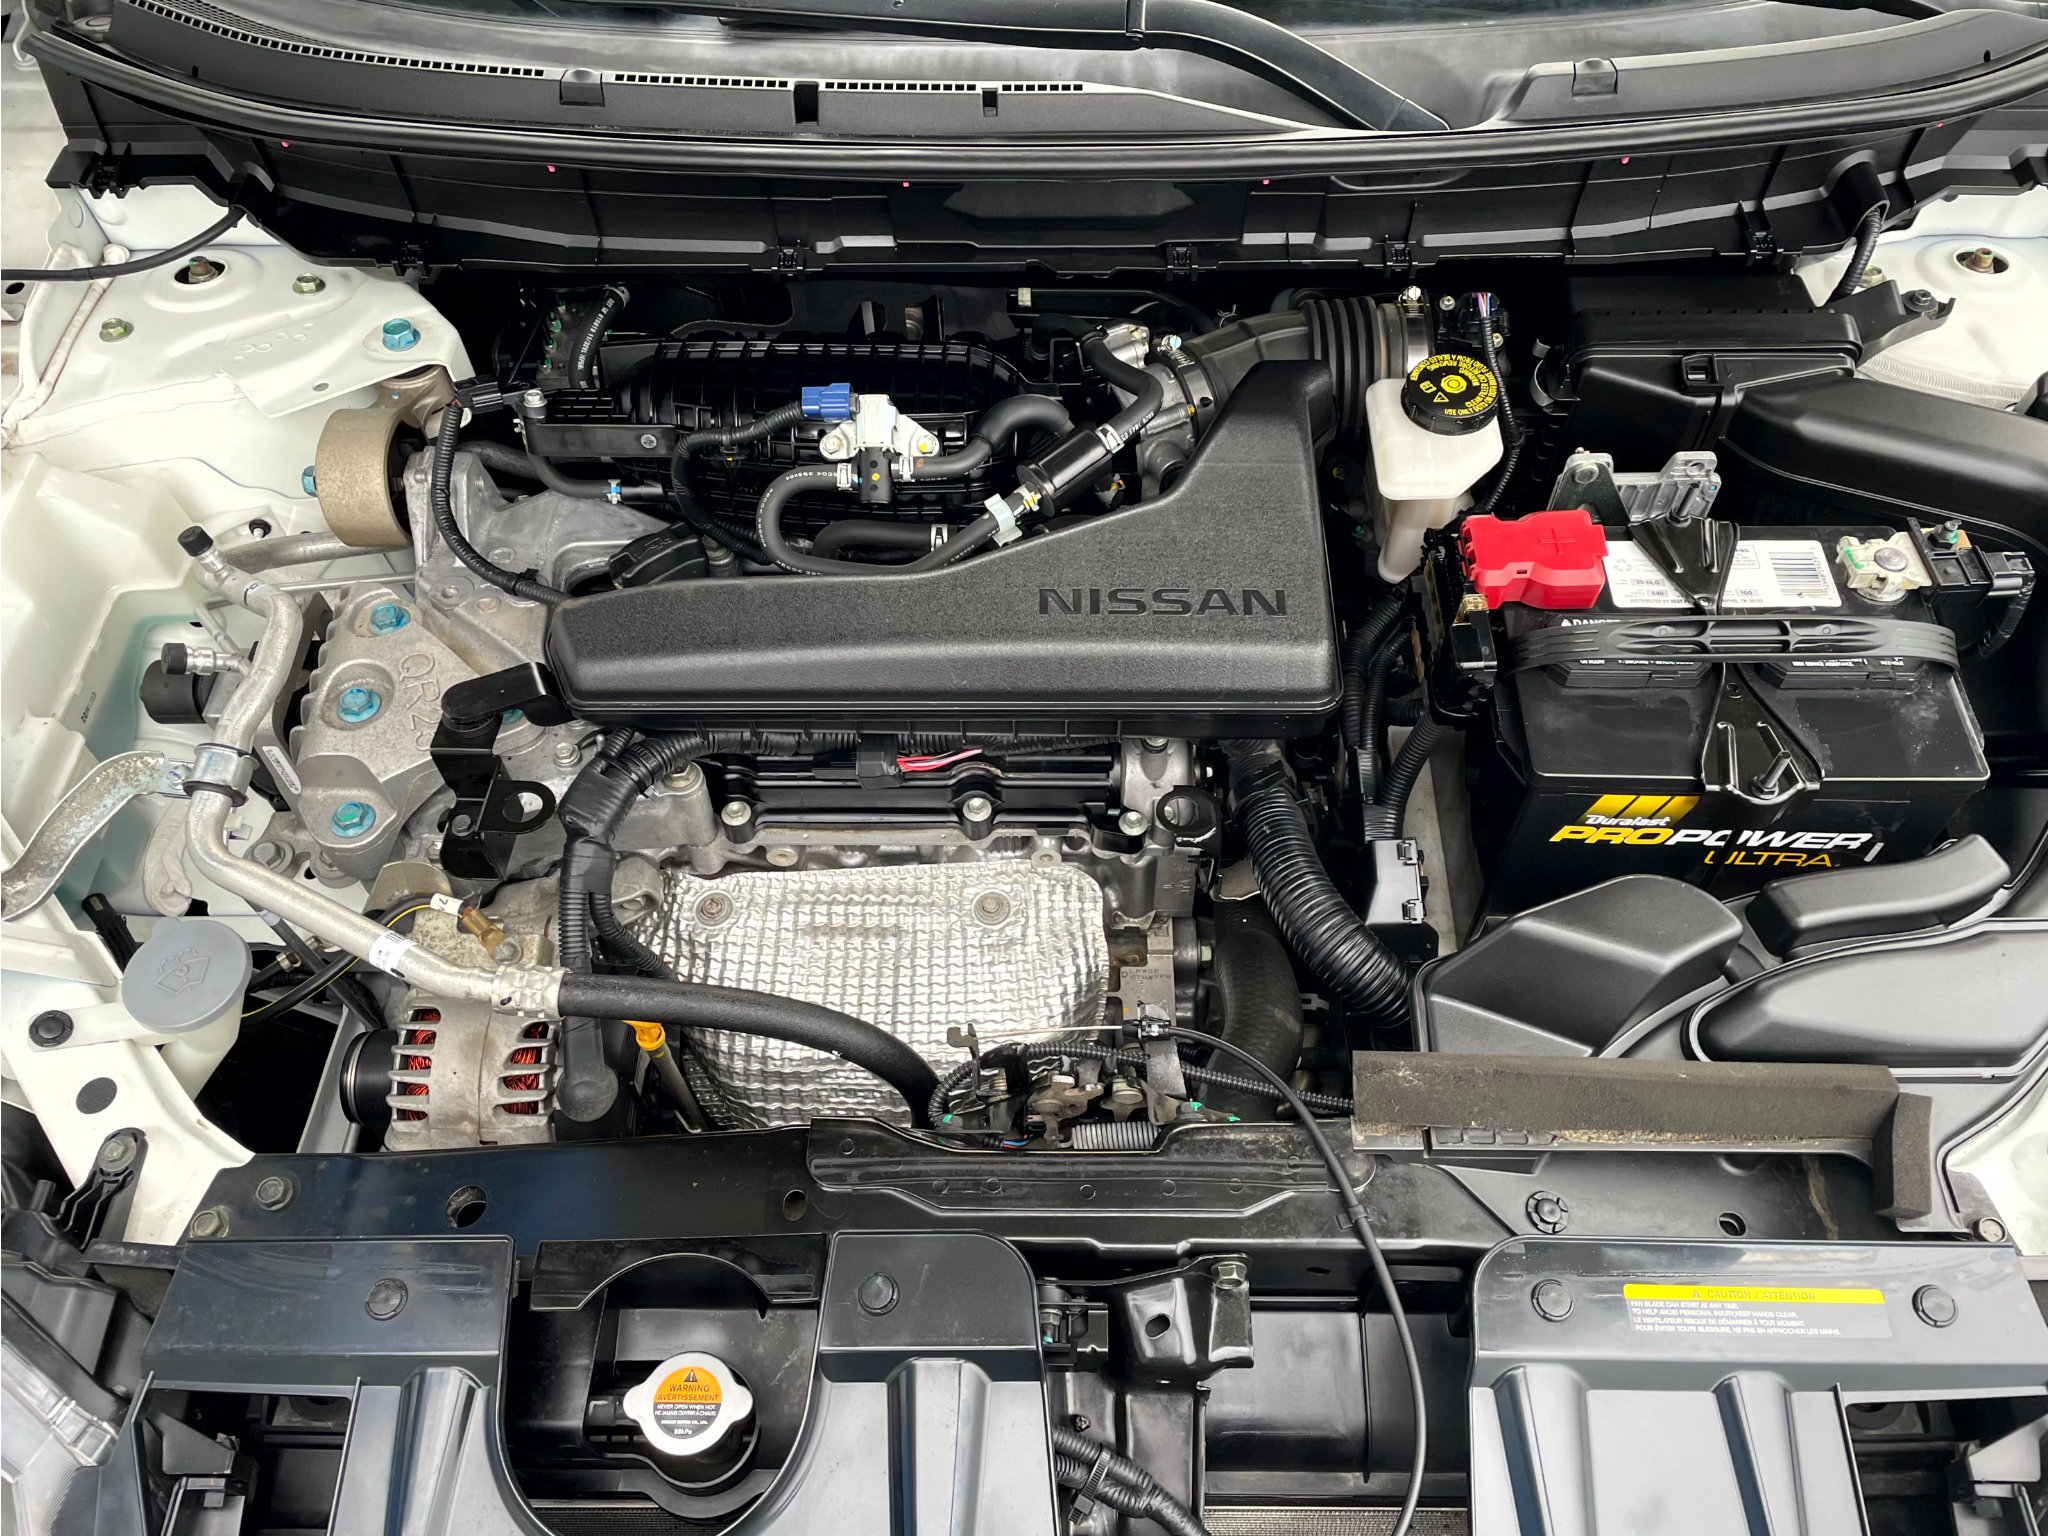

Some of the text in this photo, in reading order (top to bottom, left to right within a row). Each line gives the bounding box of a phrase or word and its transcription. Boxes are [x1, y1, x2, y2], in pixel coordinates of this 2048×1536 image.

[1039, 588, 1287, 616] NISSAN
[1585, 814, 1672, 826] Duralast
[1708, 1290, 1751, 1299] CAUTION
[1762, 1291, 1816, 1300] ATTENTION
[670, 1384, 710, 1392] WARNING
